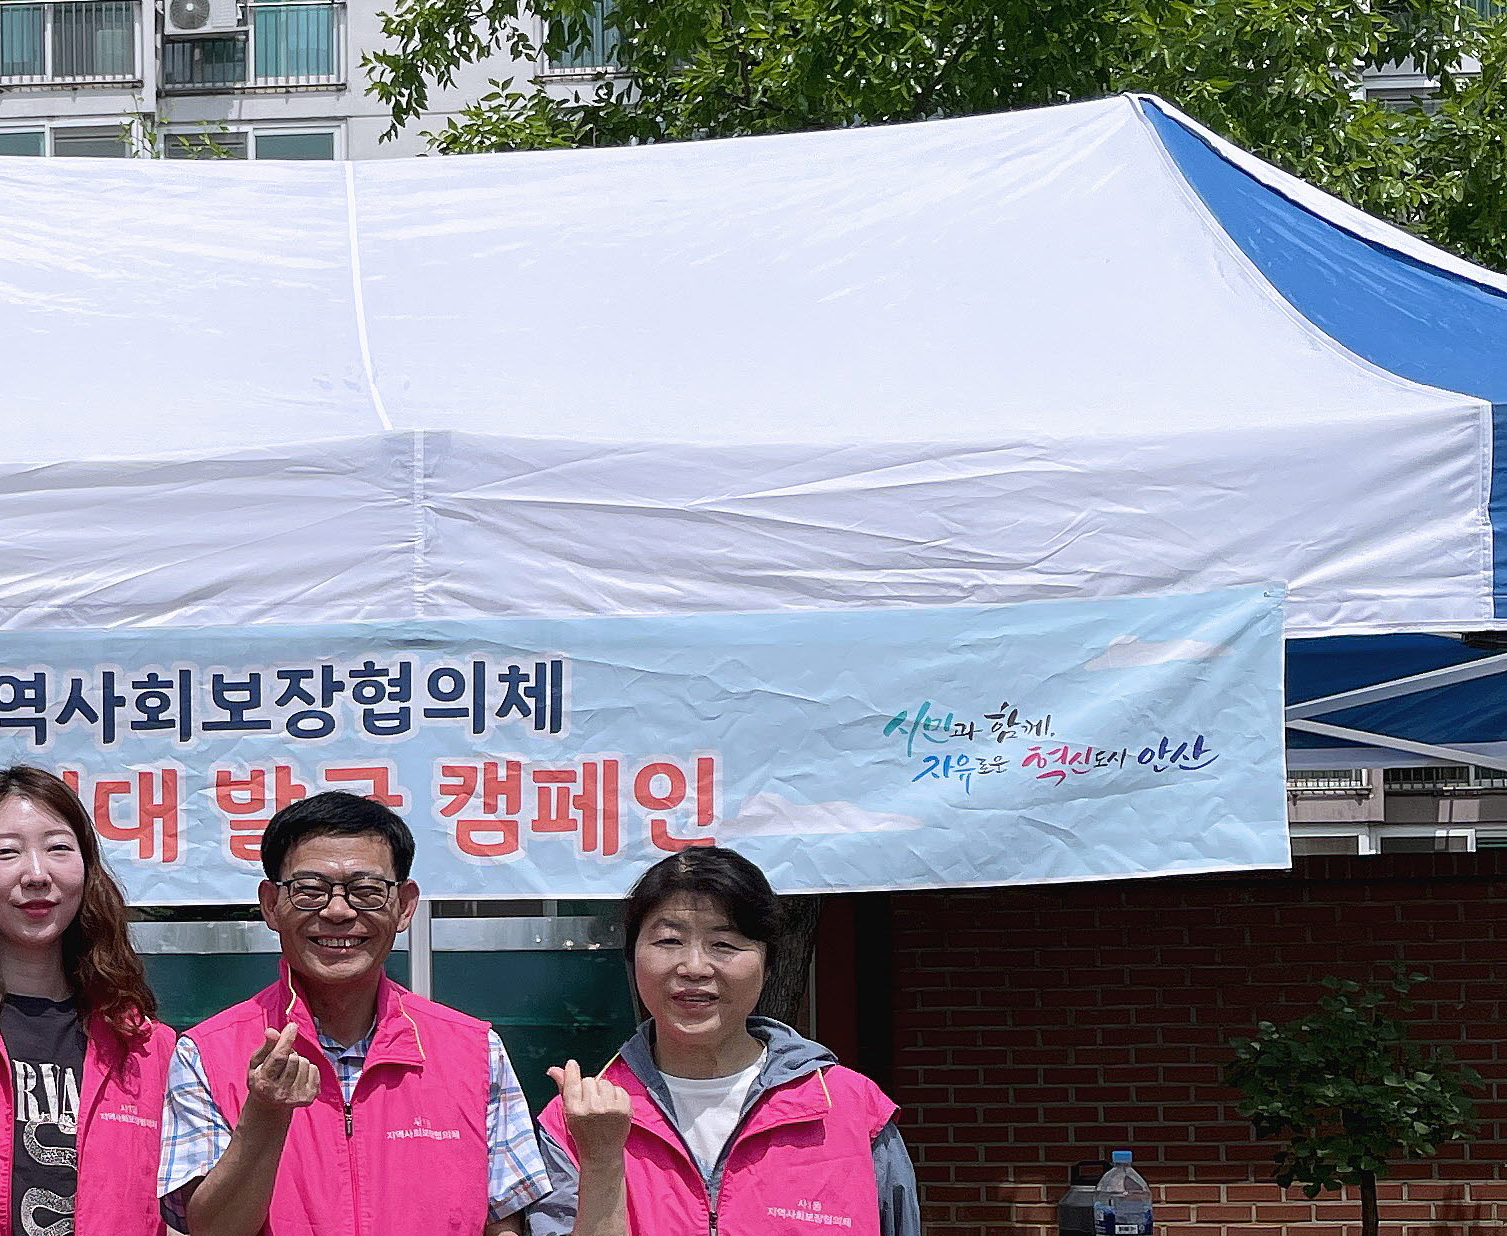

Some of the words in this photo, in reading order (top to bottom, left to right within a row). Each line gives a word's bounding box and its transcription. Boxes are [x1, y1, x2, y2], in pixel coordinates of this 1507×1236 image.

[883, 701, 983, 757] 시민과
[912, 754, 1008, 794] 자유로운
[1022, 746, 1127, 787] 혁신도시
[1137, 734, 1220, 773] 안산
[441, 758, 716, 858] 캠페인
